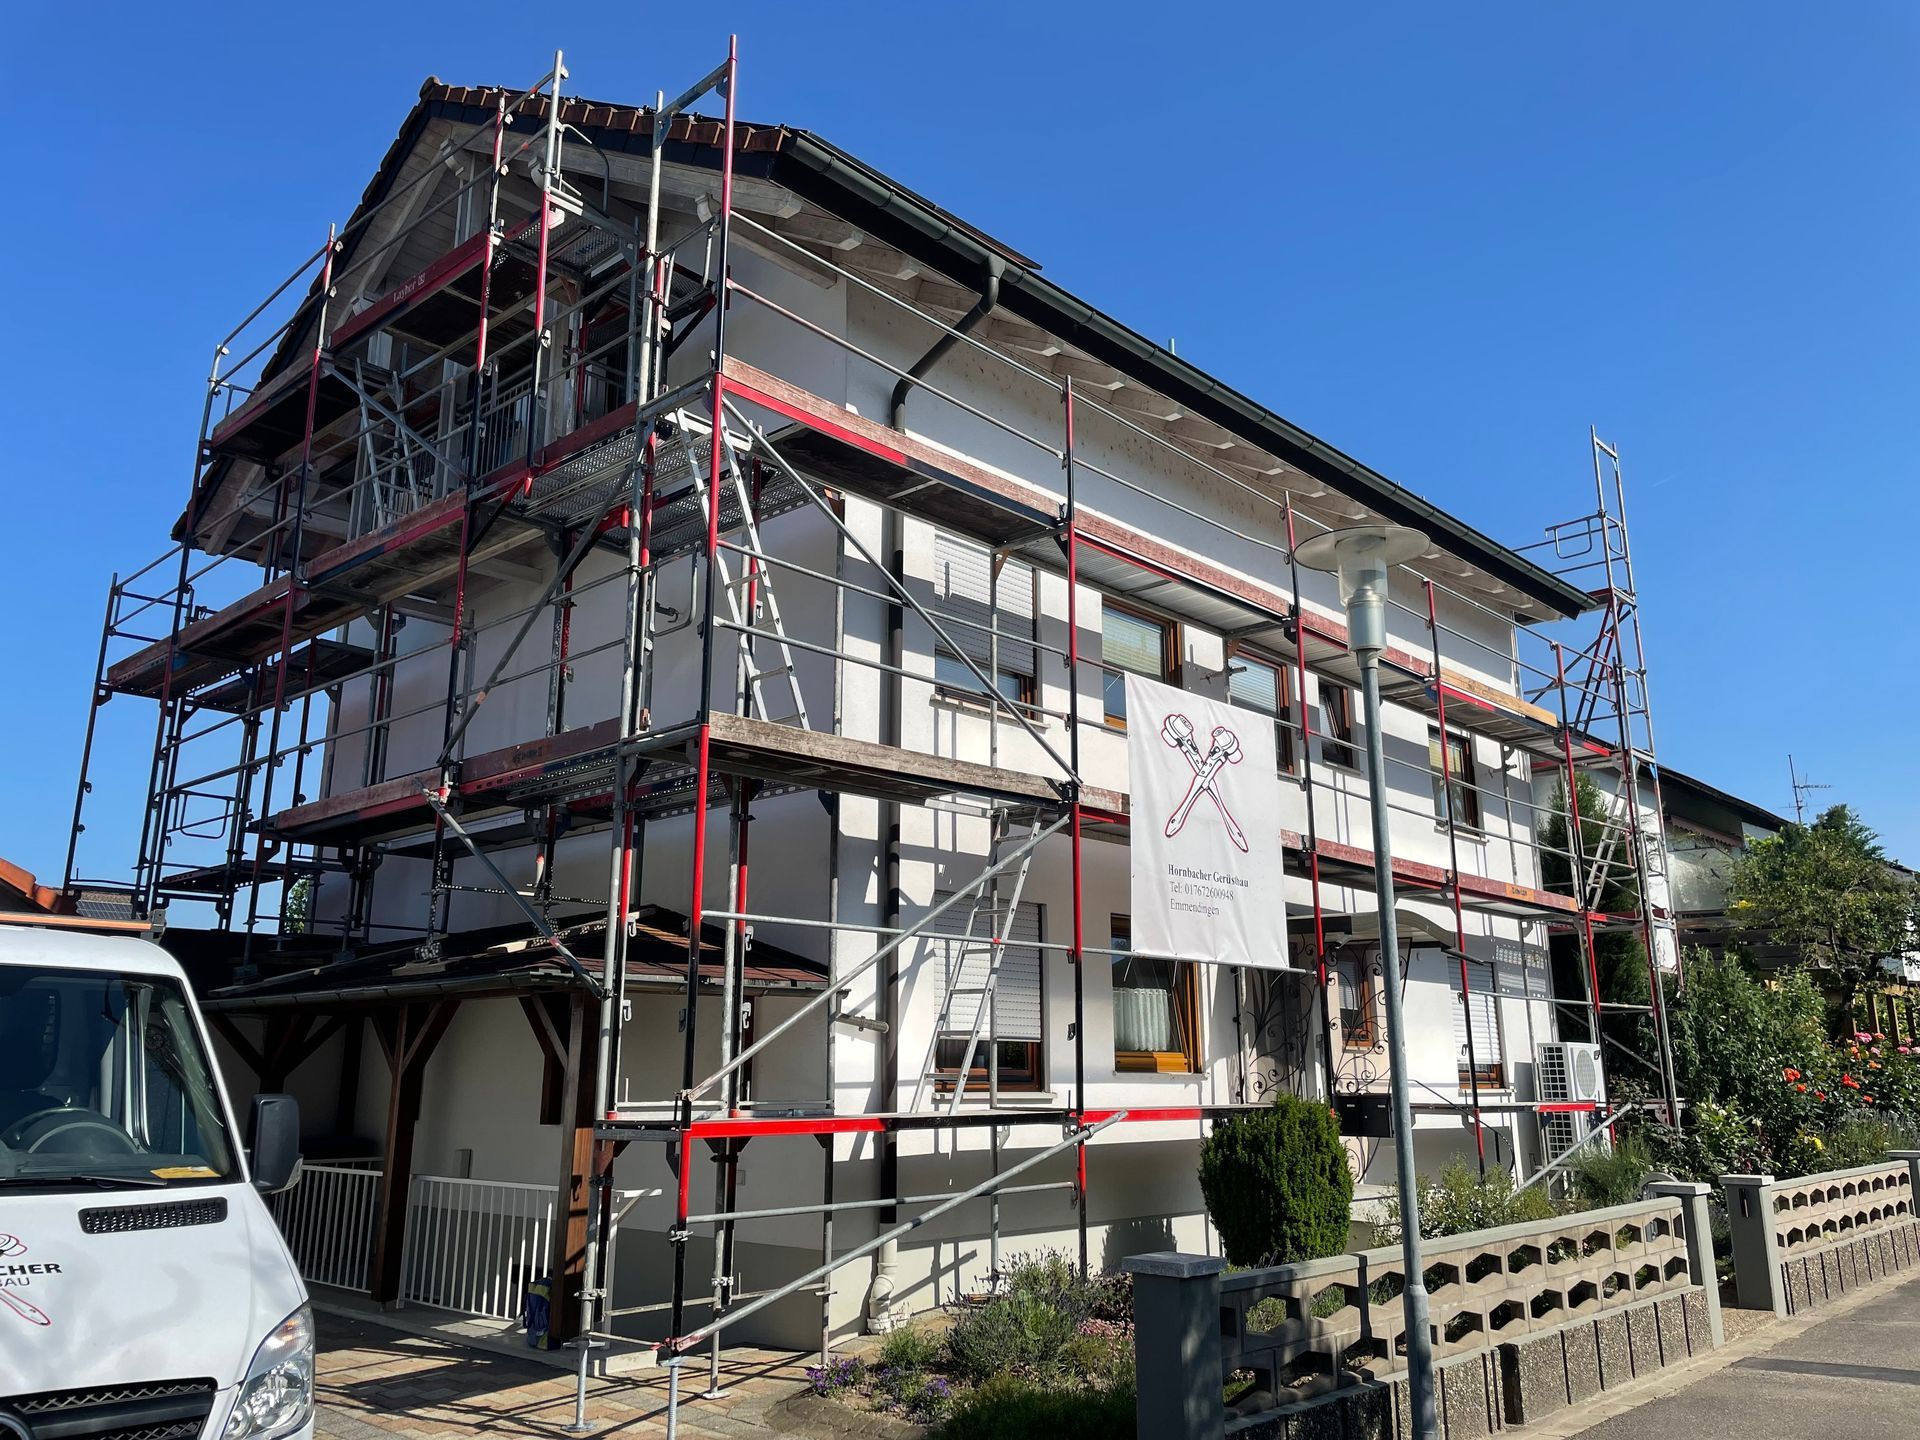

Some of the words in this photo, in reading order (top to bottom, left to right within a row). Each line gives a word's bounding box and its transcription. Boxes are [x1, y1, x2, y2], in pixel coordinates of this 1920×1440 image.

[1168, 864, 1211, 881] Hornbacher
[1169, 881, 1183, 894] Tel:
[1184, 883, 1234, 901] 017672600948
[1170, 898, 1219, 917] Emmendingen
[0, 1277, 31, 1287] AU
